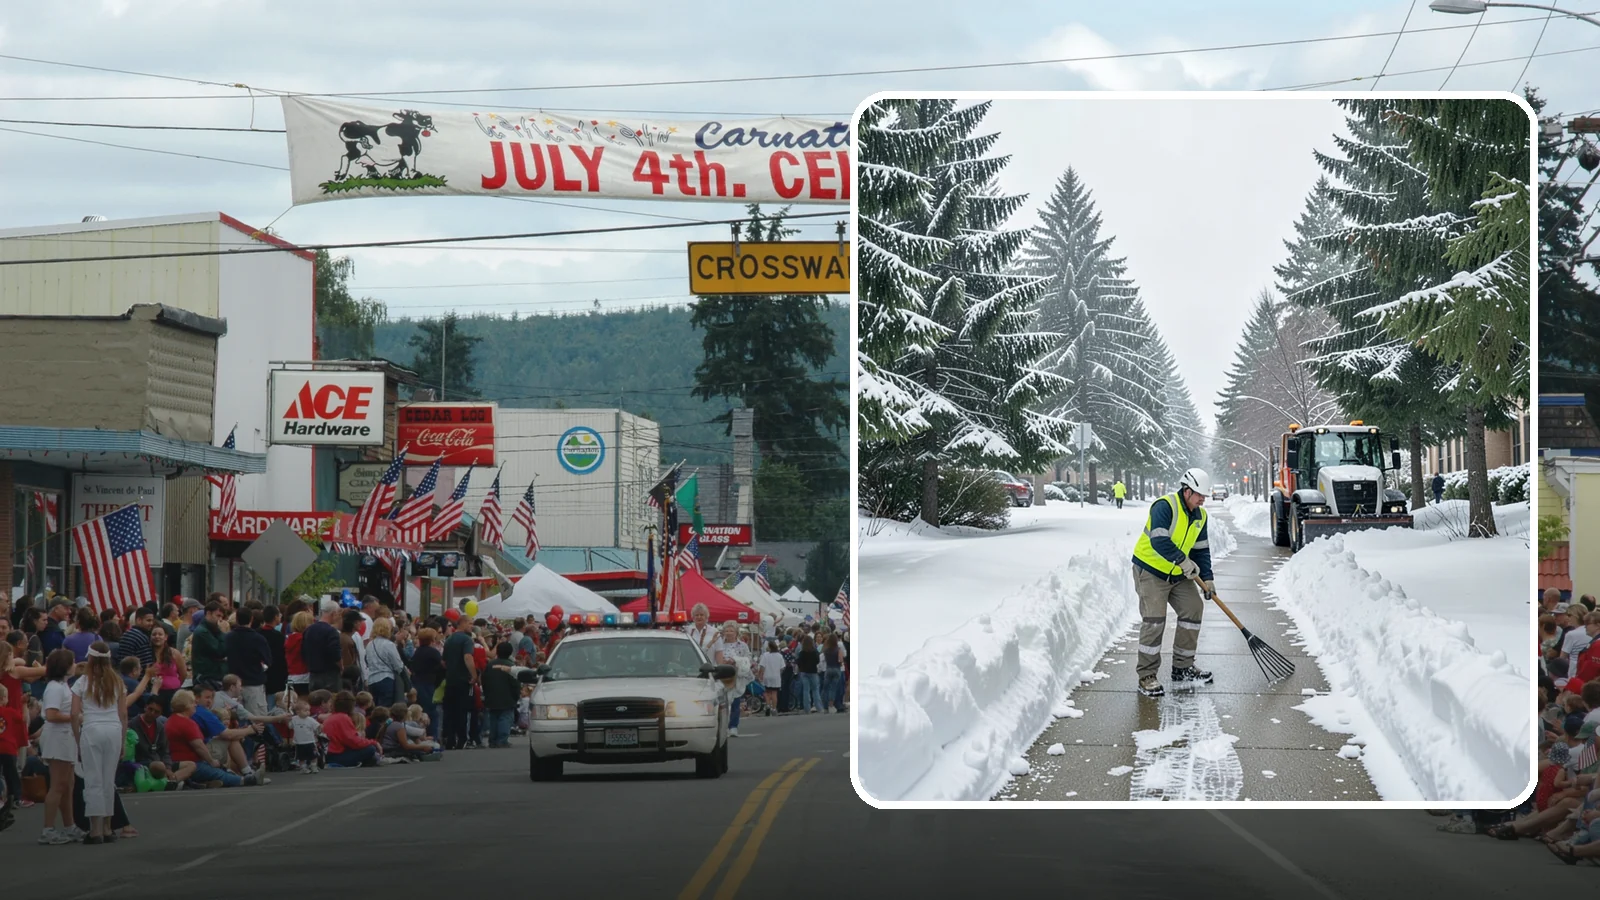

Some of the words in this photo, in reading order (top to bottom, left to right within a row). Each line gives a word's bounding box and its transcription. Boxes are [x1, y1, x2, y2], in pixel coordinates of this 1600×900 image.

[481, 141, 605, 192] JULY
[632, 150, 746, 197] 4th.
[697, 254, 850, 280] CROSSWA
[283, 380, 373, 420] ACE
[406, 409, 452, 422] CEDAR
[461, 408, 485, 421] LOG
[284, 421, 371, 436] Hardware
[416, 428, 477, 446] Coca-Cola
[95, 485, 124, 494] Vincent
[126, 486, 136, 494] de
[138, 486, 155, 495] Paul
[212, 516, 330, 536] HARDARE
[688, 526, 741, 535] CRNATION
[699, 535, 730, 543] GLASS
